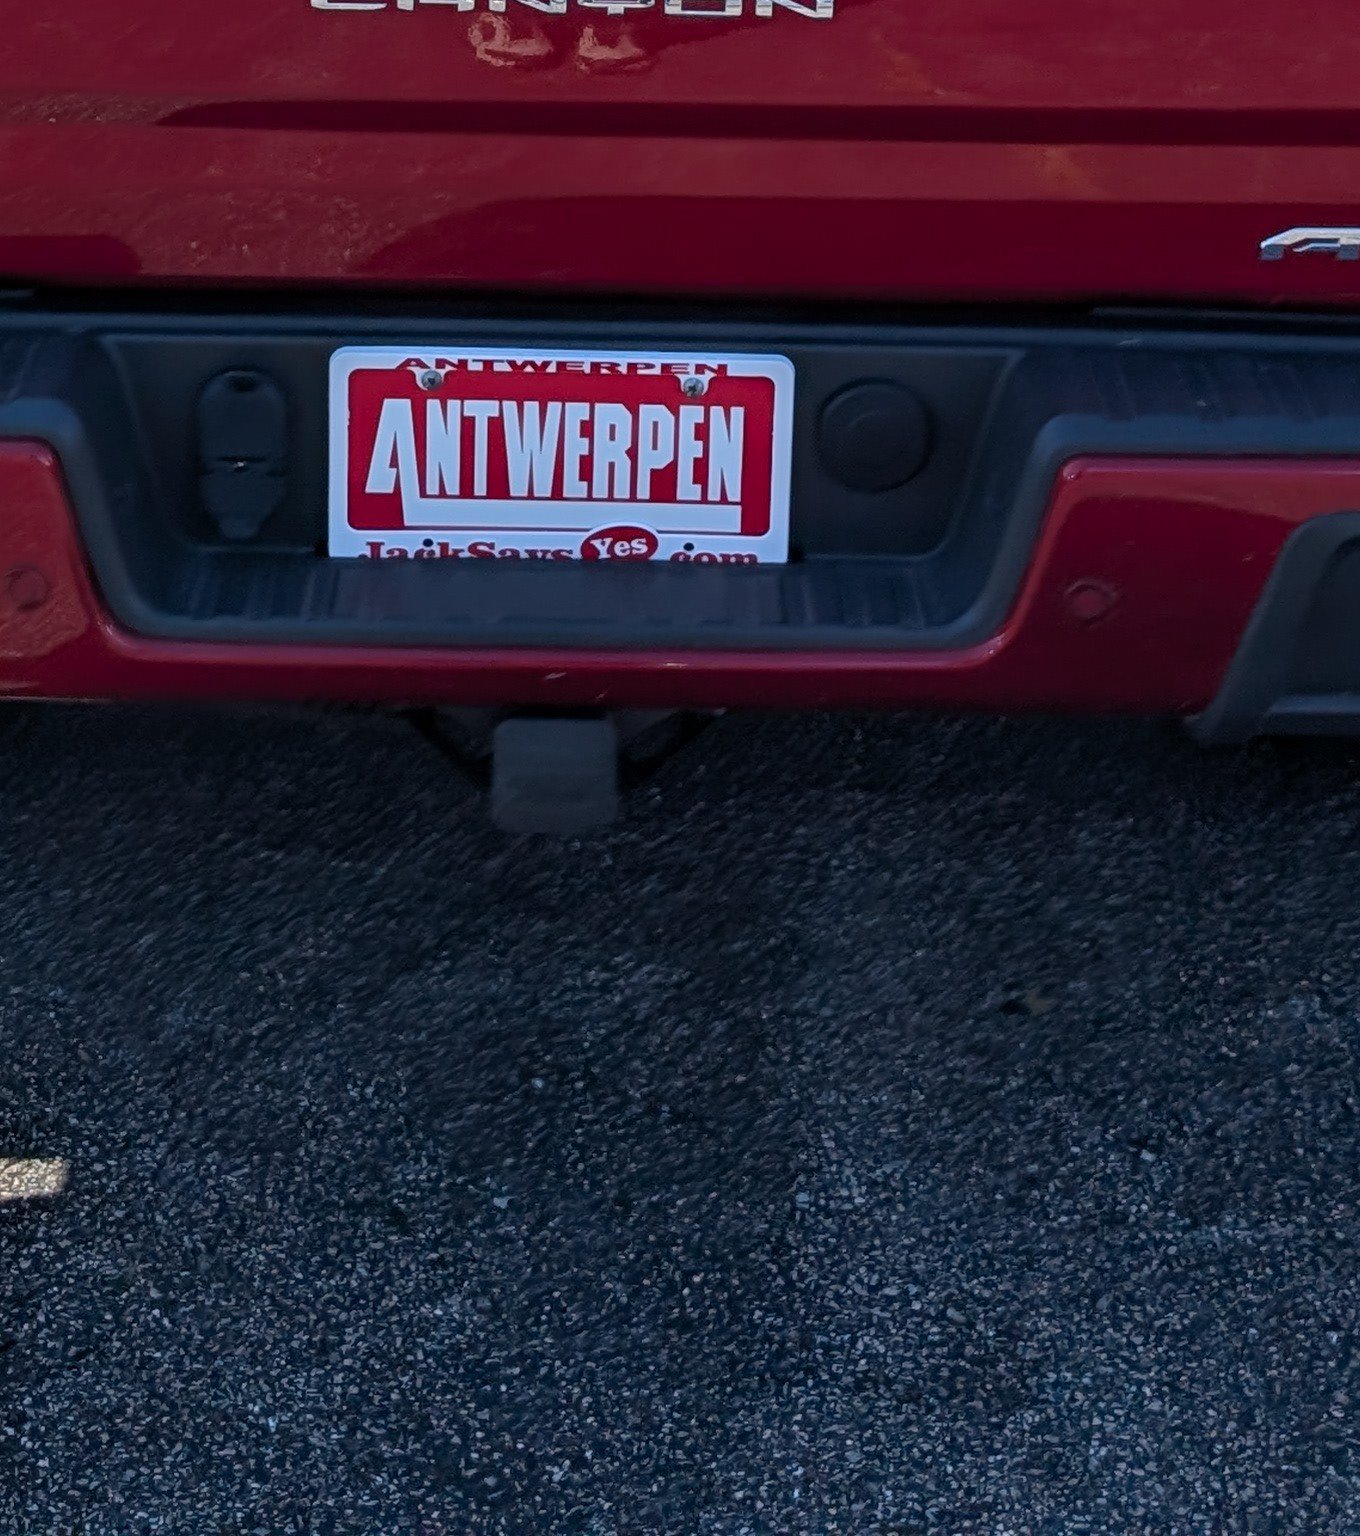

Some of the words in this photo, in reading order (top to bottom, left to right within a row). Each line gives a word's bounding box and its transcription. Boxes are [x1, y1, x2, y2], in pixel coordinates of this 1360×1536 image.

[395, 357, 728, 376] ANTWERPEN
[364, 398, 745, 504] ANTWERPEN
[591, 537, 649, 559] Yes
